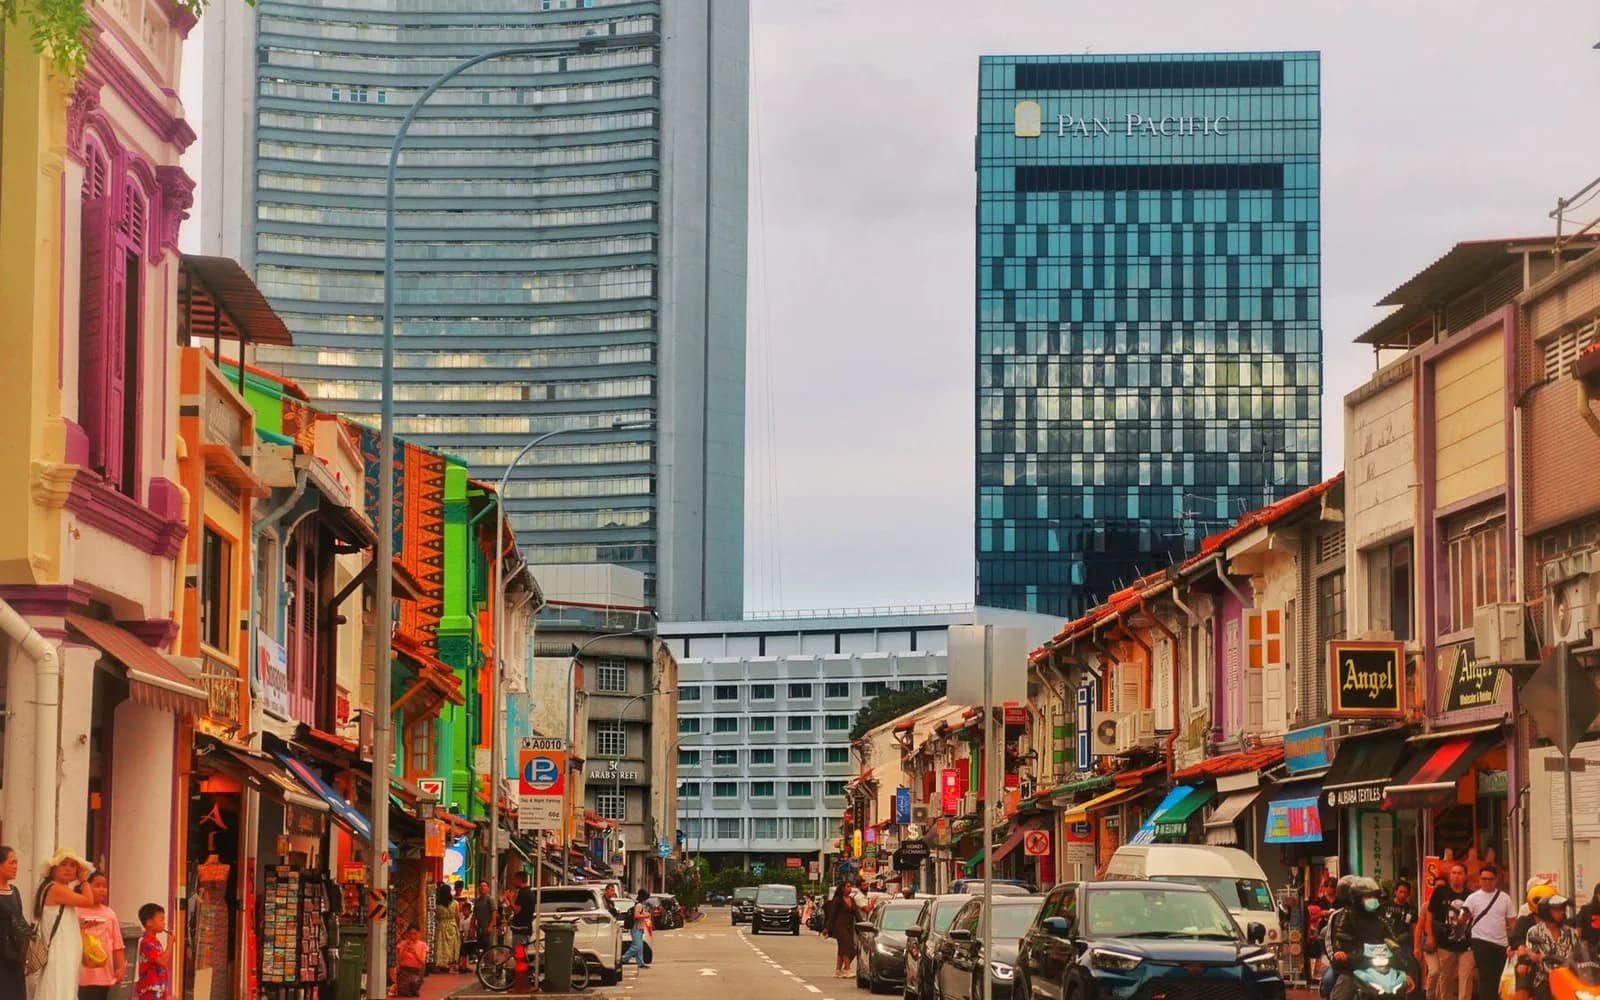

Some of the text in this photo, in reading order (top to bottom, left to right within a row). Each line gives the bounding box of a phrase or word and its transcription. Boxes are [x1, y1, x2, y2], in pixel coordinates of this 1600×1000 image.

[1343, 658, 1393, 699] Angel
[533, 740, 562, 750] A0010
[531, 758, 555, 781] P
[590, 770, 638, 780] ARAB SREET
[1337, 789, 1358, 805] ALIBABA
[1358, 787, 1381, 803] TEXTILES
